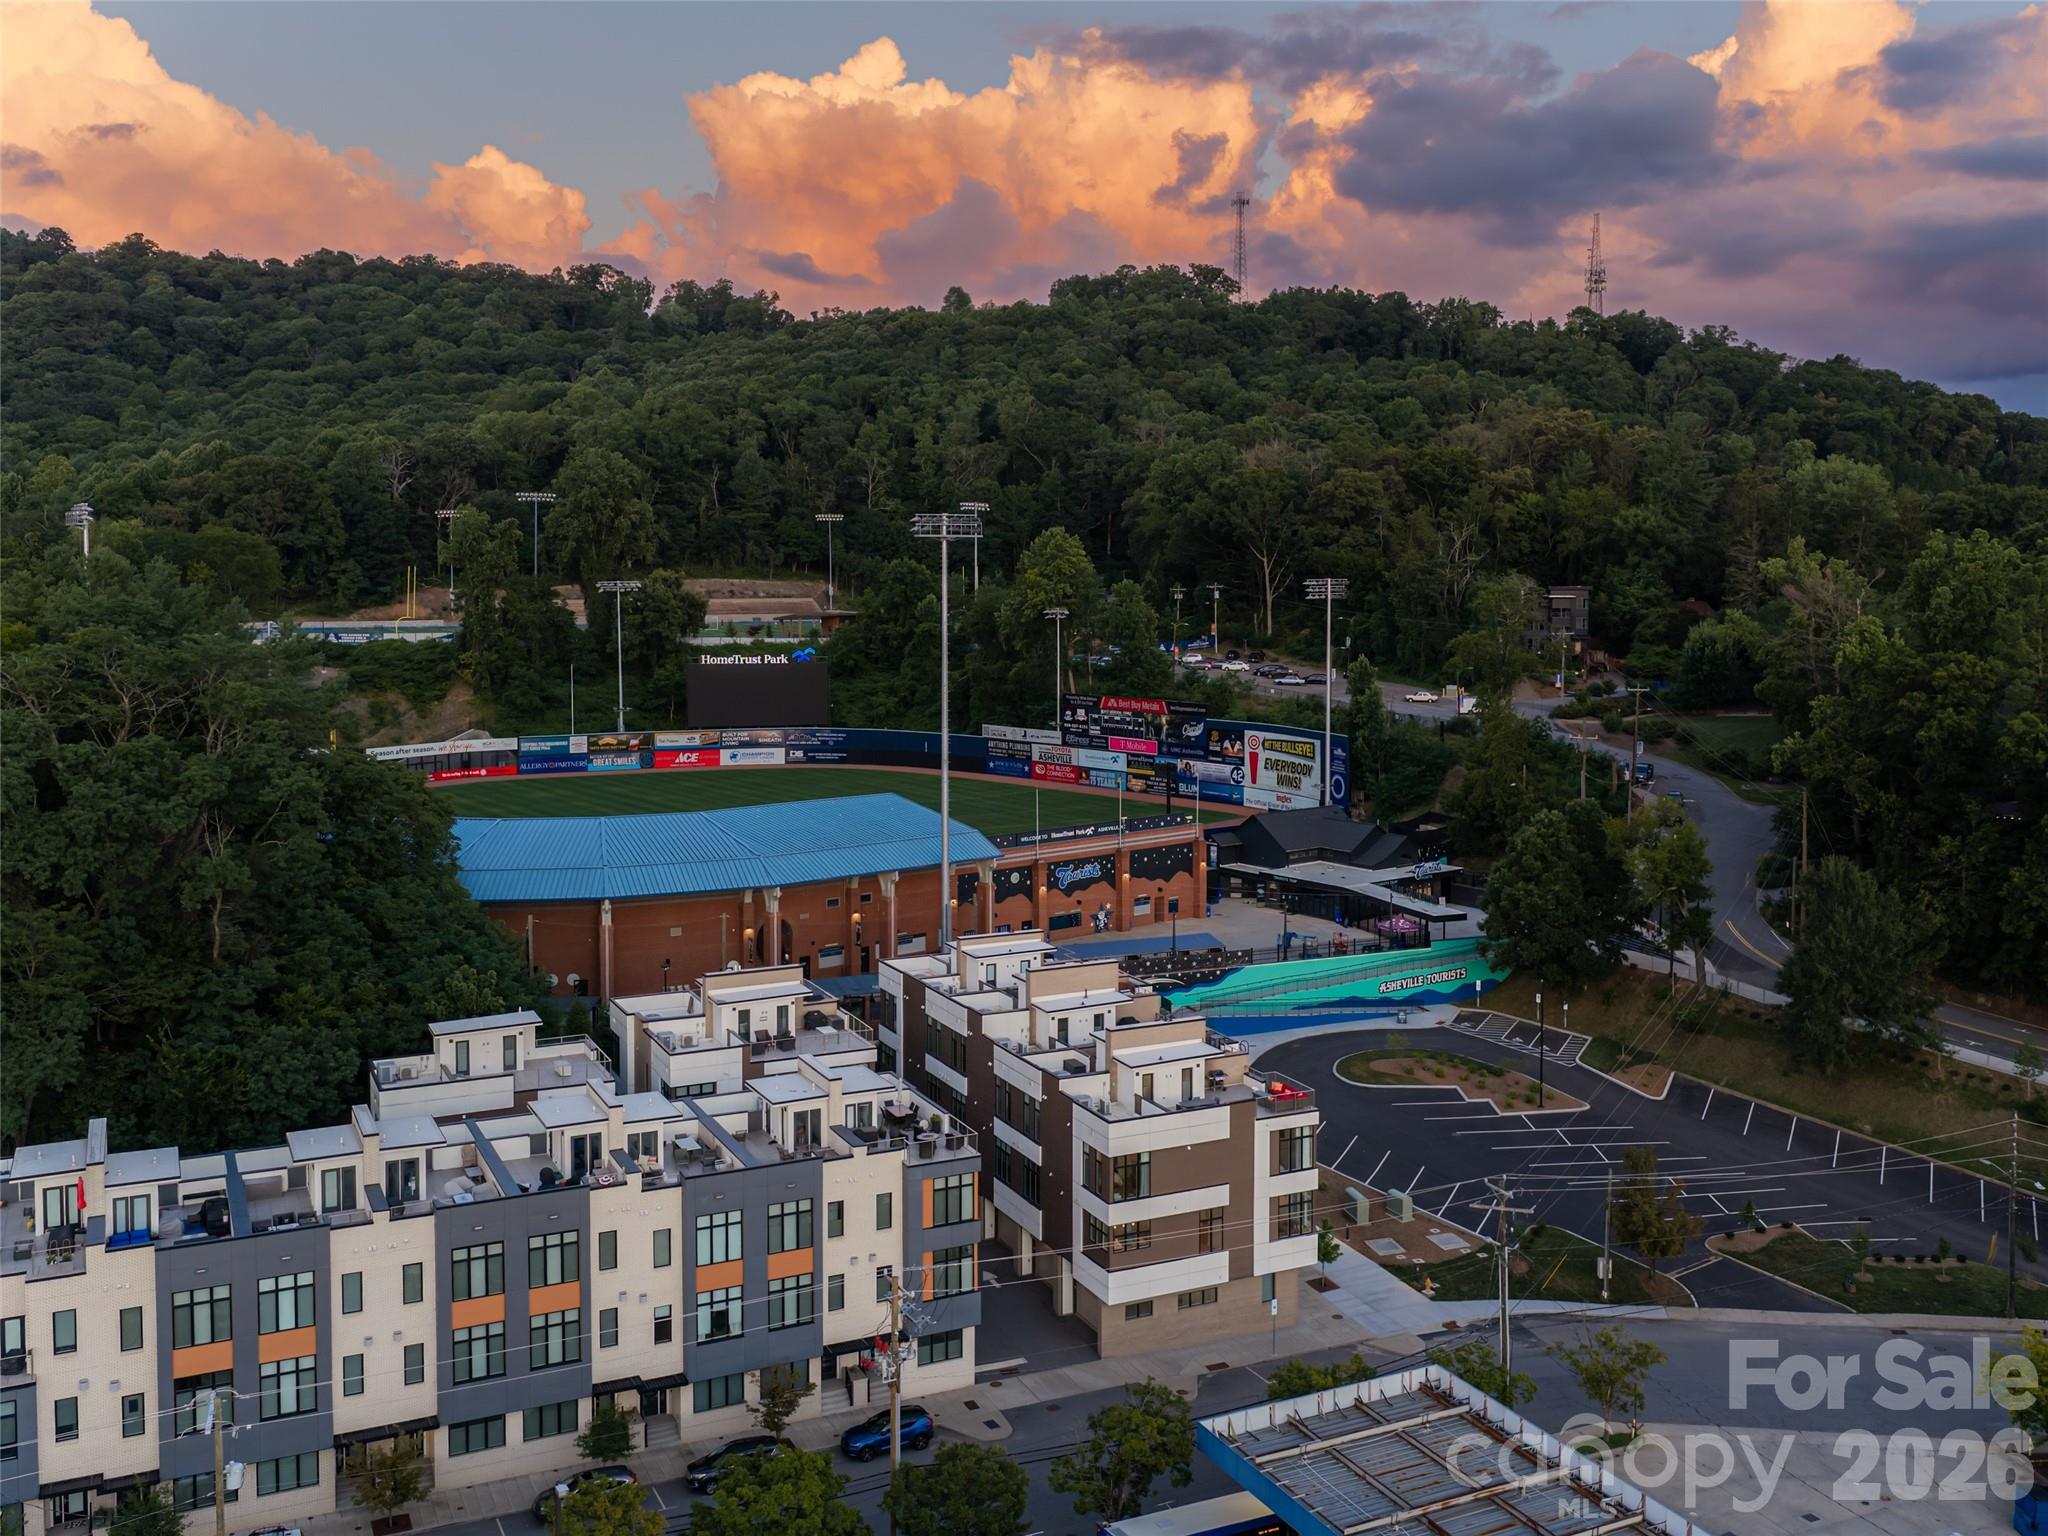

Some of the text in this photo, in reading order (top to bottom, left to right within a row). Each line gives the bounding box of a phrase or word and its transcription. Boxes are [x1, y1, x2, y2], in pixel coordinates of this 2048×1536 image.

[700, 654, 788, 664] HomeTrust Park
[395, 747, 411, 756] after
[1051, 746, 1072, 754] TOYOTA
[1272, 741, 1281, 750] THE
[1282, 742, 1314, 757] BULLSEYE!
[592, 757, 636, 766] GREAT SMILES
[674, 752, 699, 763] ACE
[1038, 754, 1072, 764] ASHEVILLE
[520, 762, 548, 770] ALLERGY
[1264, 757, 1313, 776] EVERYBODY
[1046, 769, 1075, 779] CONNECTION
[1231, 769, 1243, 782] 42
[1276, 774, 1301, 789] WINS!
[1055, 862, 1102, 889] Tourists
[1379, 968, 1466, 993] ASHEVILLE TOURISTS
